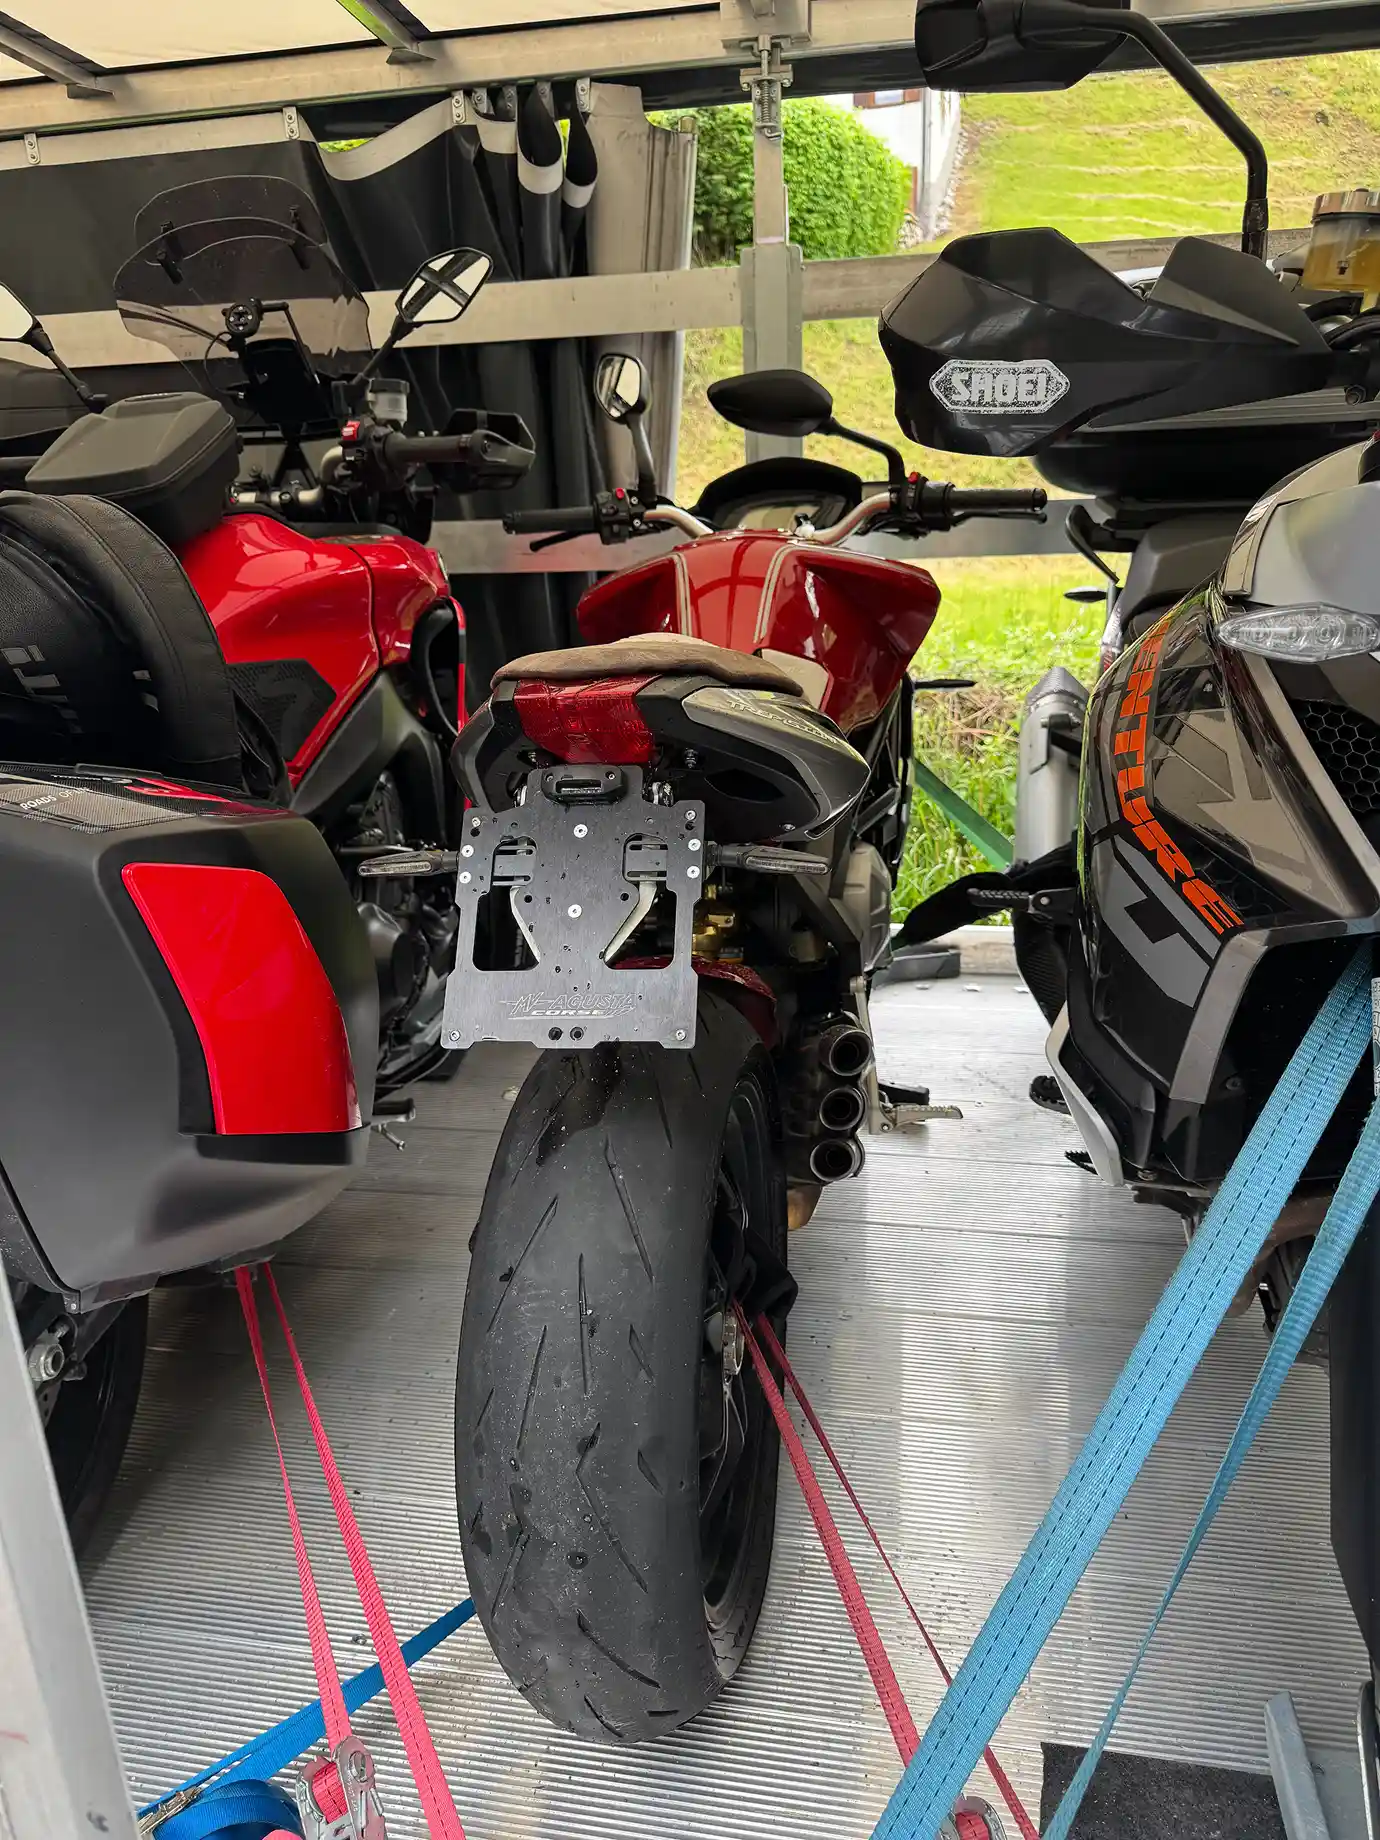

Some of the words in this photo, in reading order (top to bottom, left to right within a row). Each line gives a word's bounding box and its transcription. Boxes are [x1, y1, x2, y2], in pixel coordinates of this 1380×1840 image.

[950, 373, 1047, 401] SHOEI
[20, 795, 57, 810] ROADS
[509, 991, 544, 1015] MV
[548, 994, 637, 1010] AGUSTA
